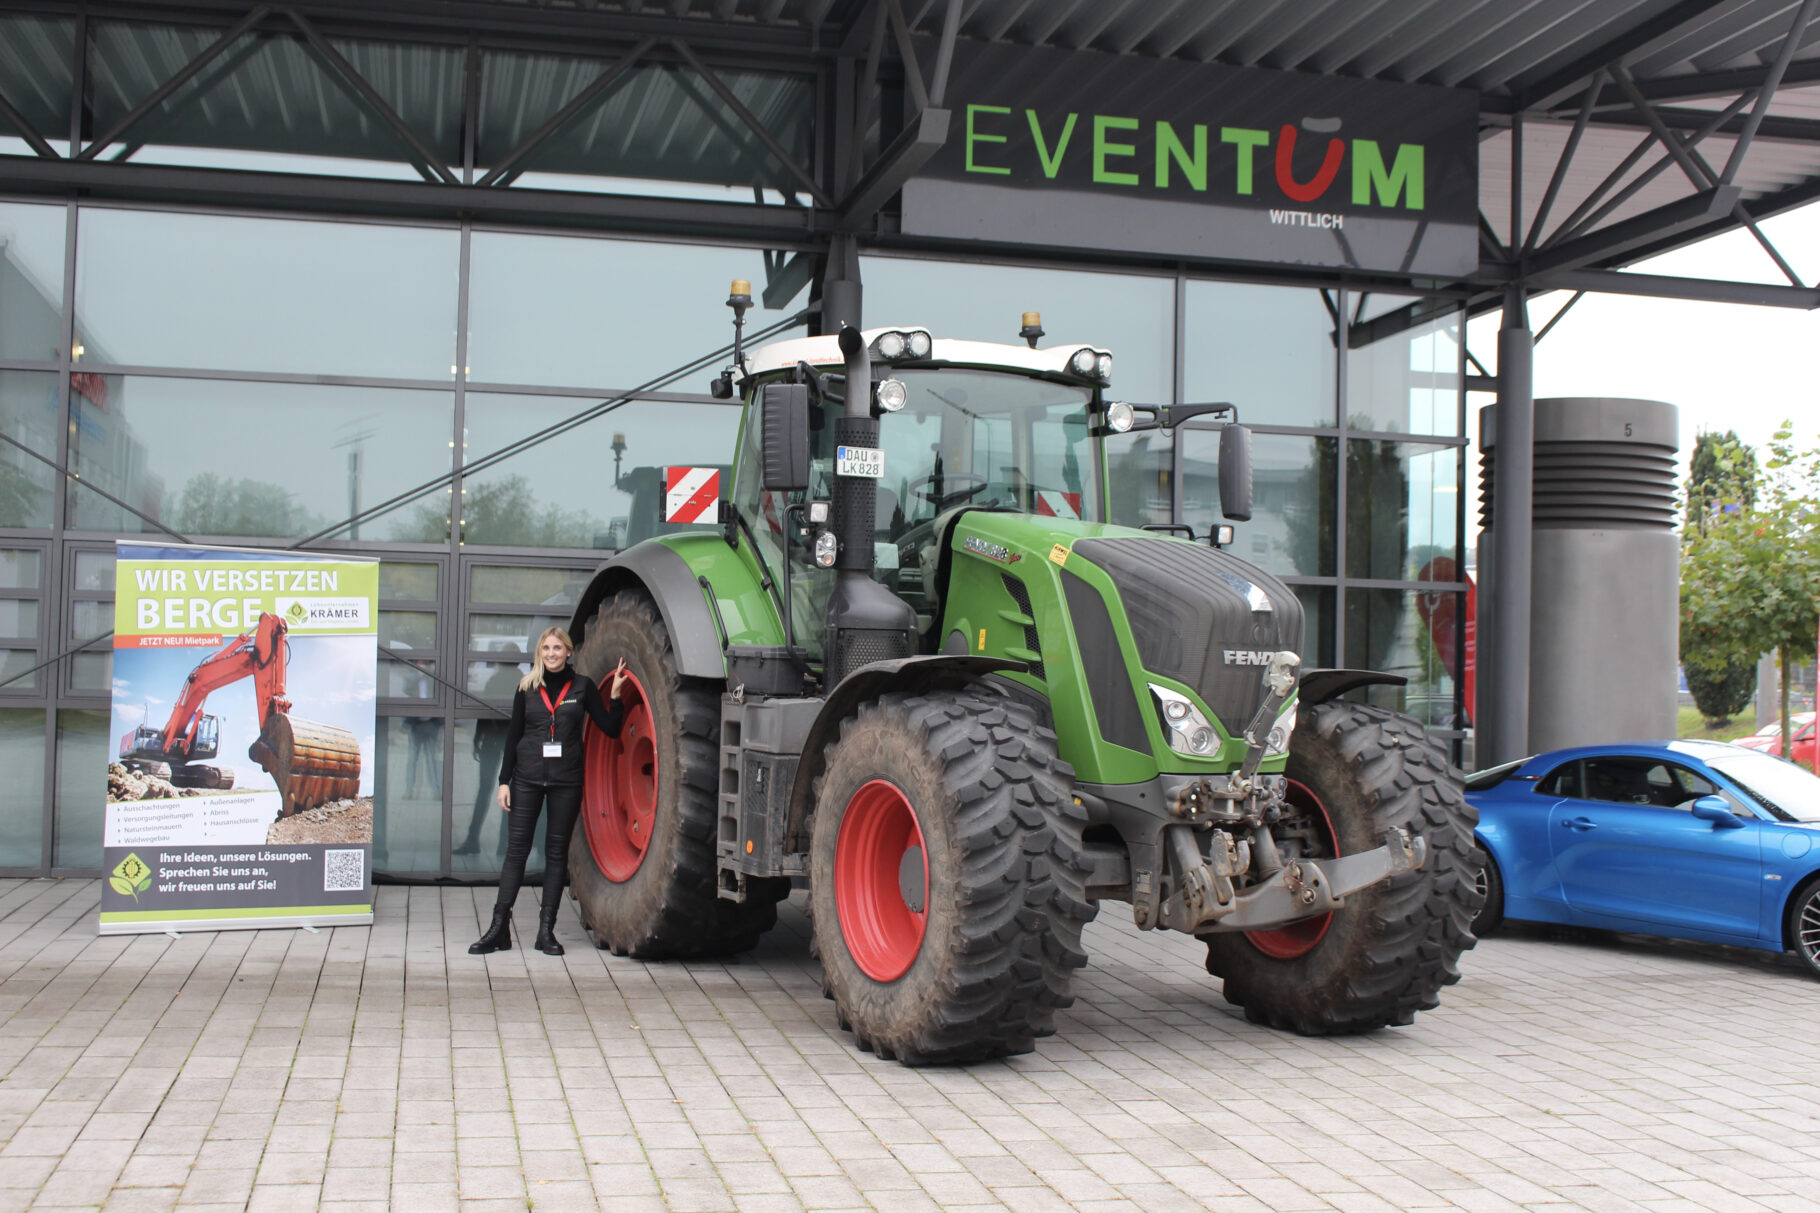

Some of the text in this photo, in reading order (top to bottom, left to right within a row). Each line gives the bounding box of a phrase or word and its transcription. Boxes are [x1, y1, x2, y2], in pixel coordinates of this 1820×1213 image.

[1269, 208, 1344, 230] WITTLICH
[1624, 423, 1633, 438] 5
[846, 449, 868, 462] DAU
[135, 569, 338, 592] WIR VERSETZEN
[137, 597, 264, 629] BERGE
[310, 607, 359, 619] KRÄMER
[139, 636, 220, 647] JETZT NEU! Mietpark
[1223, 650, 1276, 666] FEND
[123, 803, 181, 813] Ausschachtungen
[210, 797, 256, 807] Außenanlagen
[124, 812, 194, 824] Versorgungsleitungen
[210, 809, 230, 817] Abriss
[210, 817, 260, 827] Hausanschlüsse
[124, 823, 183, 834] Natursteinmauern
[124, 834, 171, 845] Waldwegebau
[159, 851, 312, 864] Ihre Ideen, unsere Lösungen.
[159, 866, 269, 880] Sprechen Sie uns an,
[158, 880, 277, 892] wir freuen uns auf Sie!
